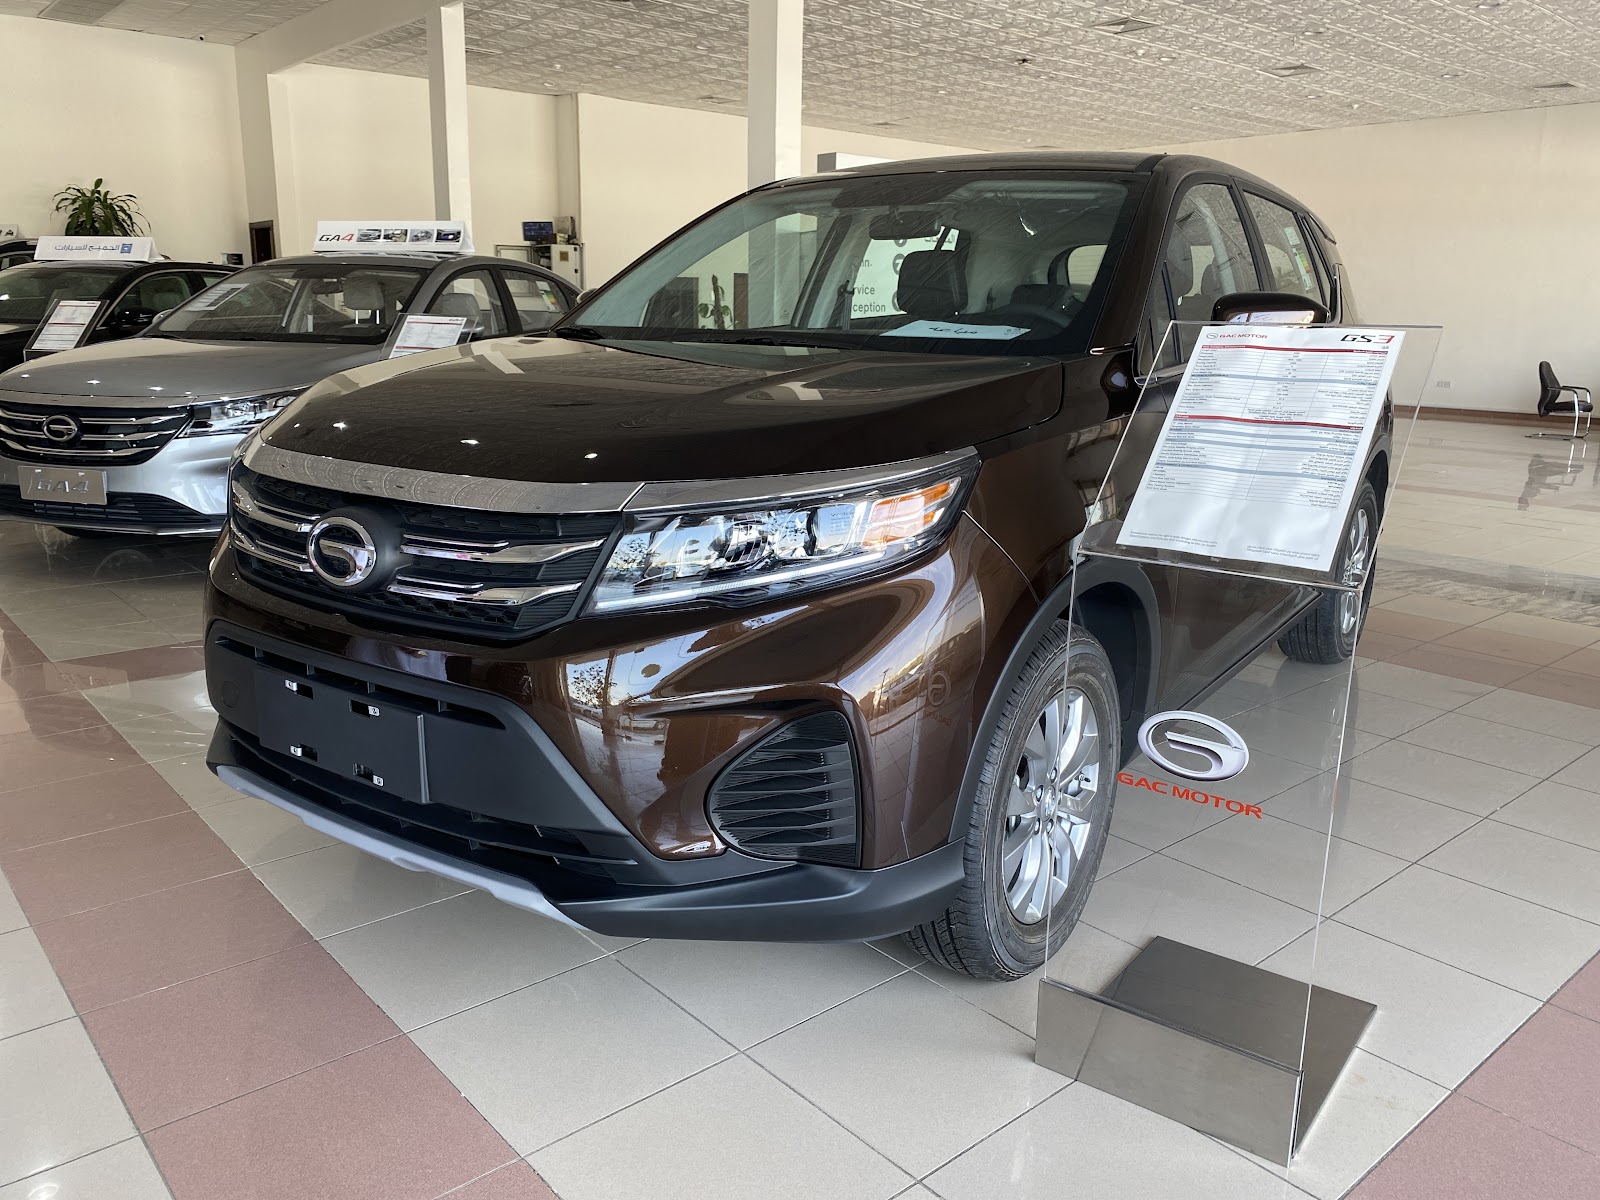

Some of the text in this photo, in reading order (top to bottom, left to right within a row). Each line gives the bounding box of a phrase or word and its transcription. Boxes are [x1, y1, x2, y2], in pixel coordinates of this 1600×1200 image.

[319, 233, 355, 242] GA4
[54, 244, 88, 252] للسيارات
[854, 284, 876, 295] rvice
[852, 301, 887, 315] ception
[1340, 334, 1395, 344] GS3
[1117, 772, 1263, 820] GAC MOTOR
